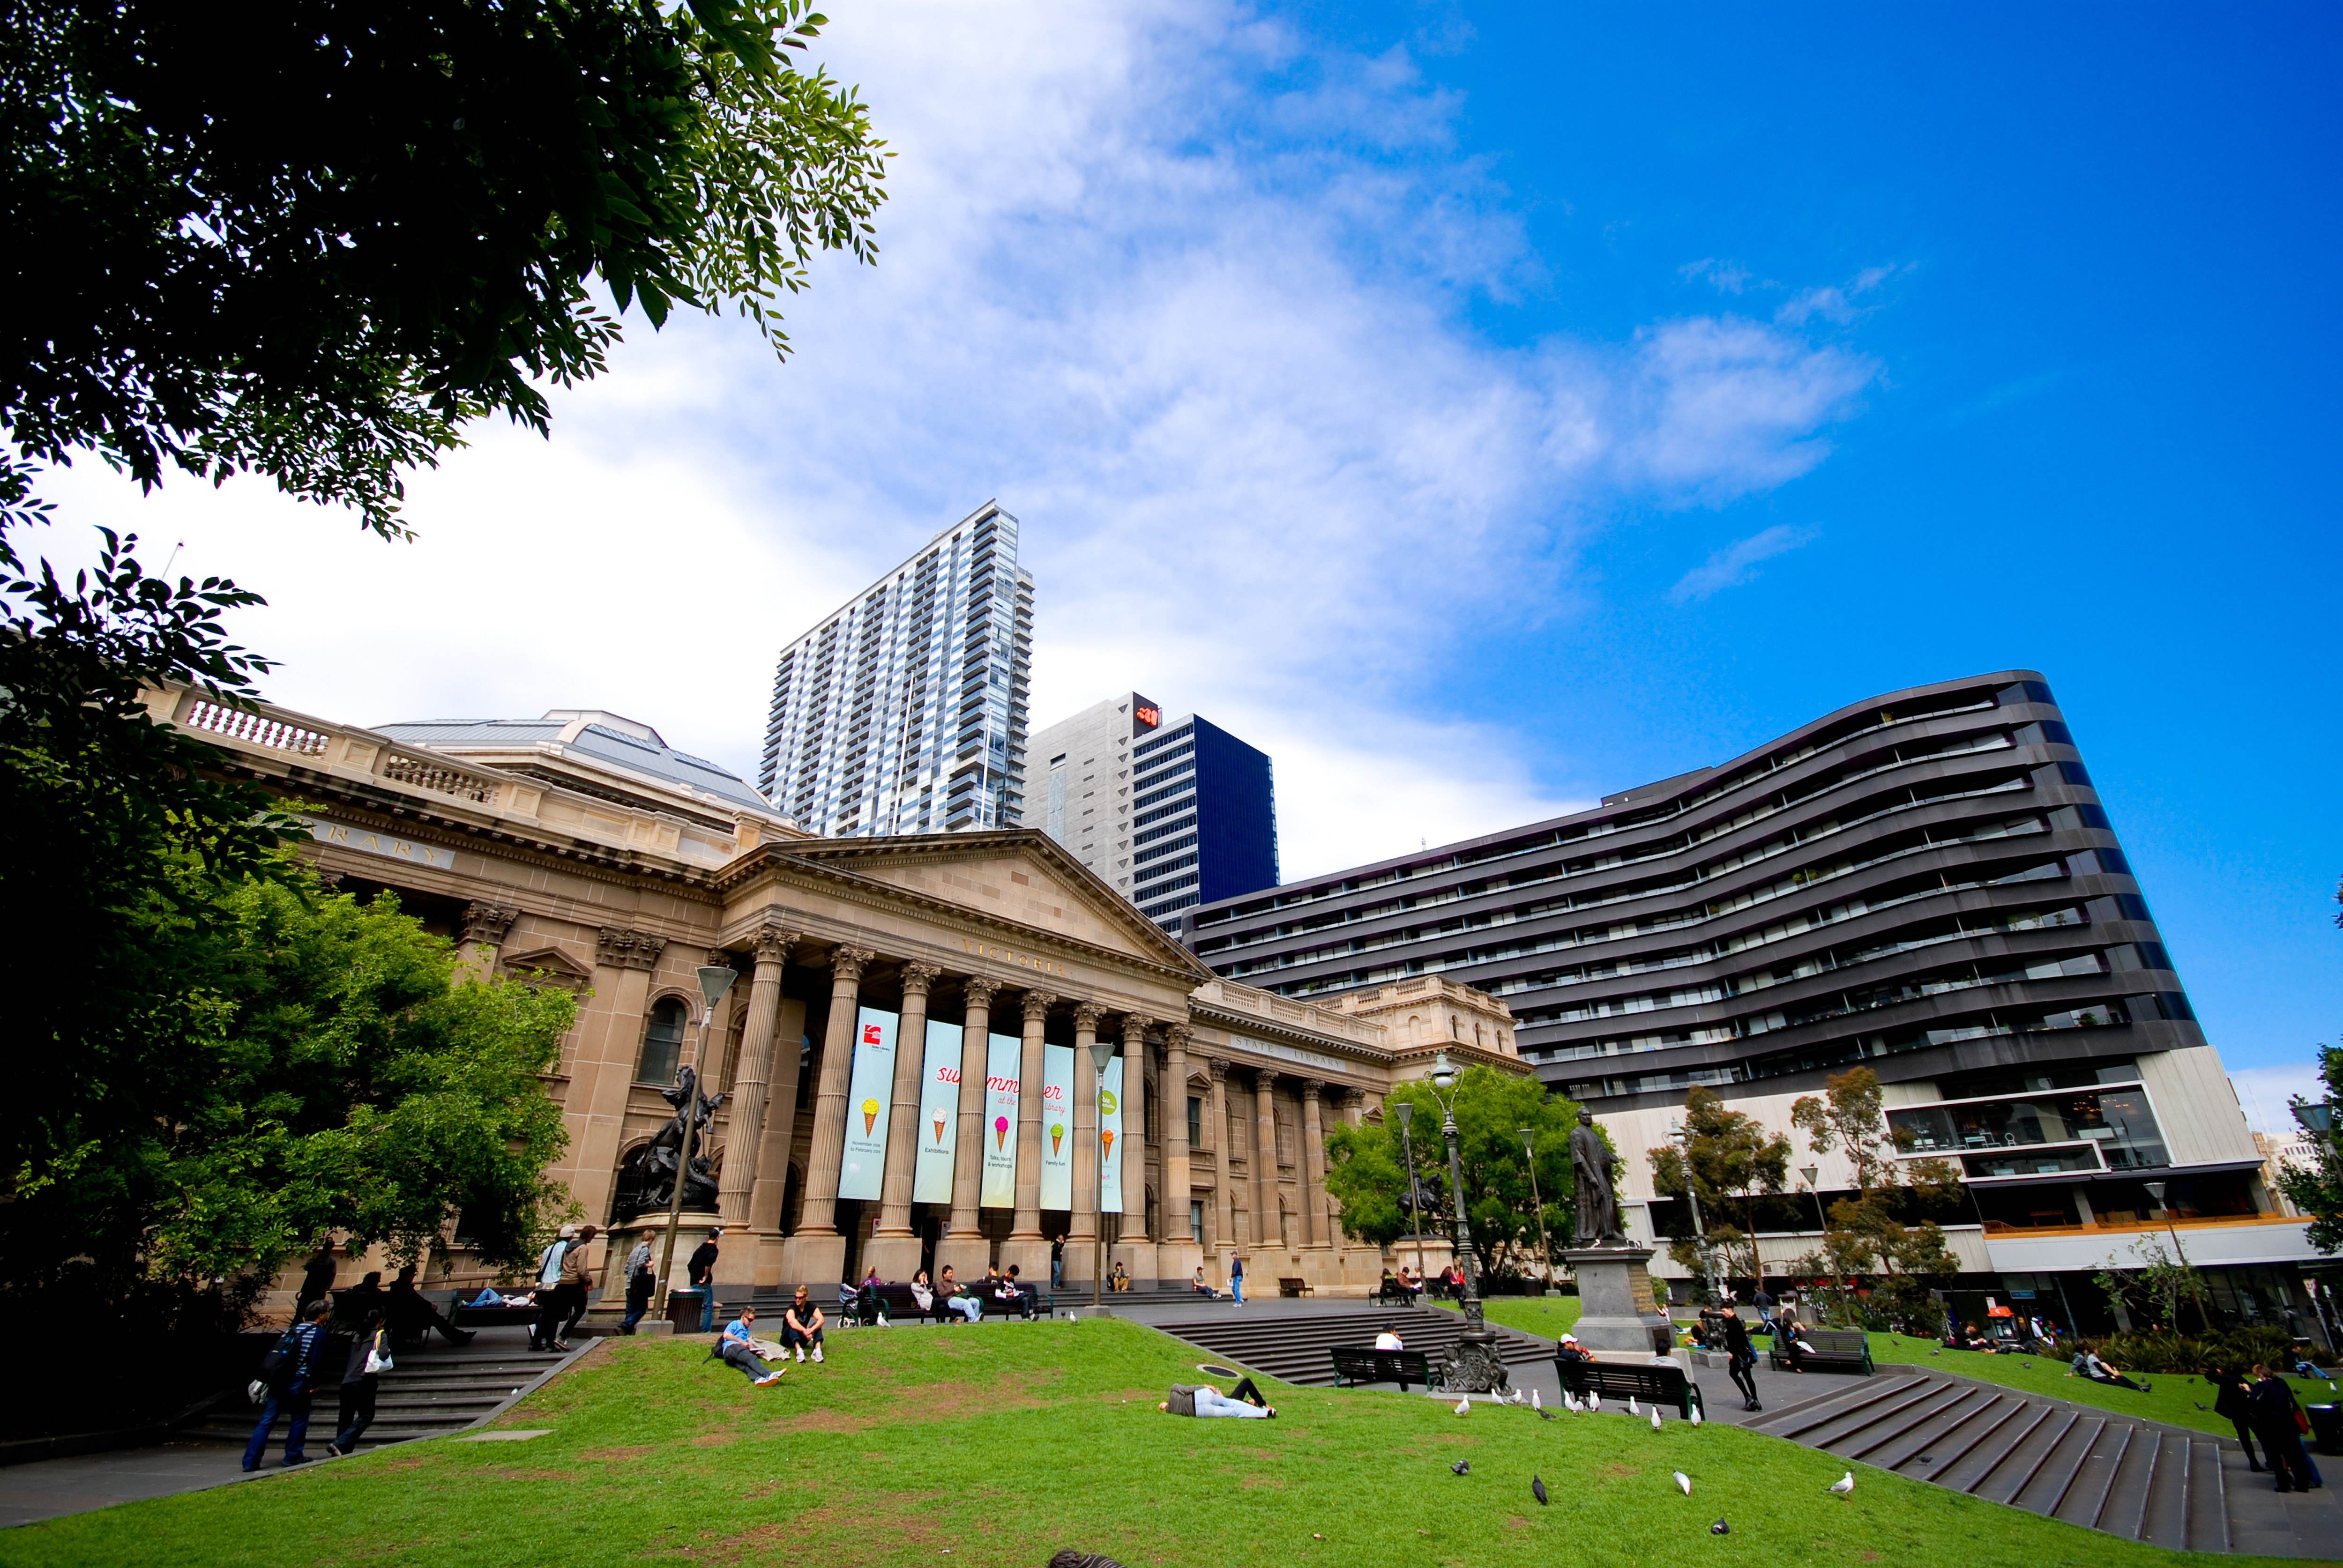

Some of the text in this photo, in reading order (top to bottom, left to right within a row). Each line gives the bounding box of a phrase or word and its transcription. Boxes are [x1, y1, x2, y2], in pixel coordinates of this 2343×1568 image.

[963, 938, 1066, 976] VICTORIA
[1236, 1037, 1341, 1068] STATE LIBRARY
[1006, 1096, 1016, 1106] the
[1045, 1102, 1066, 1116] library
